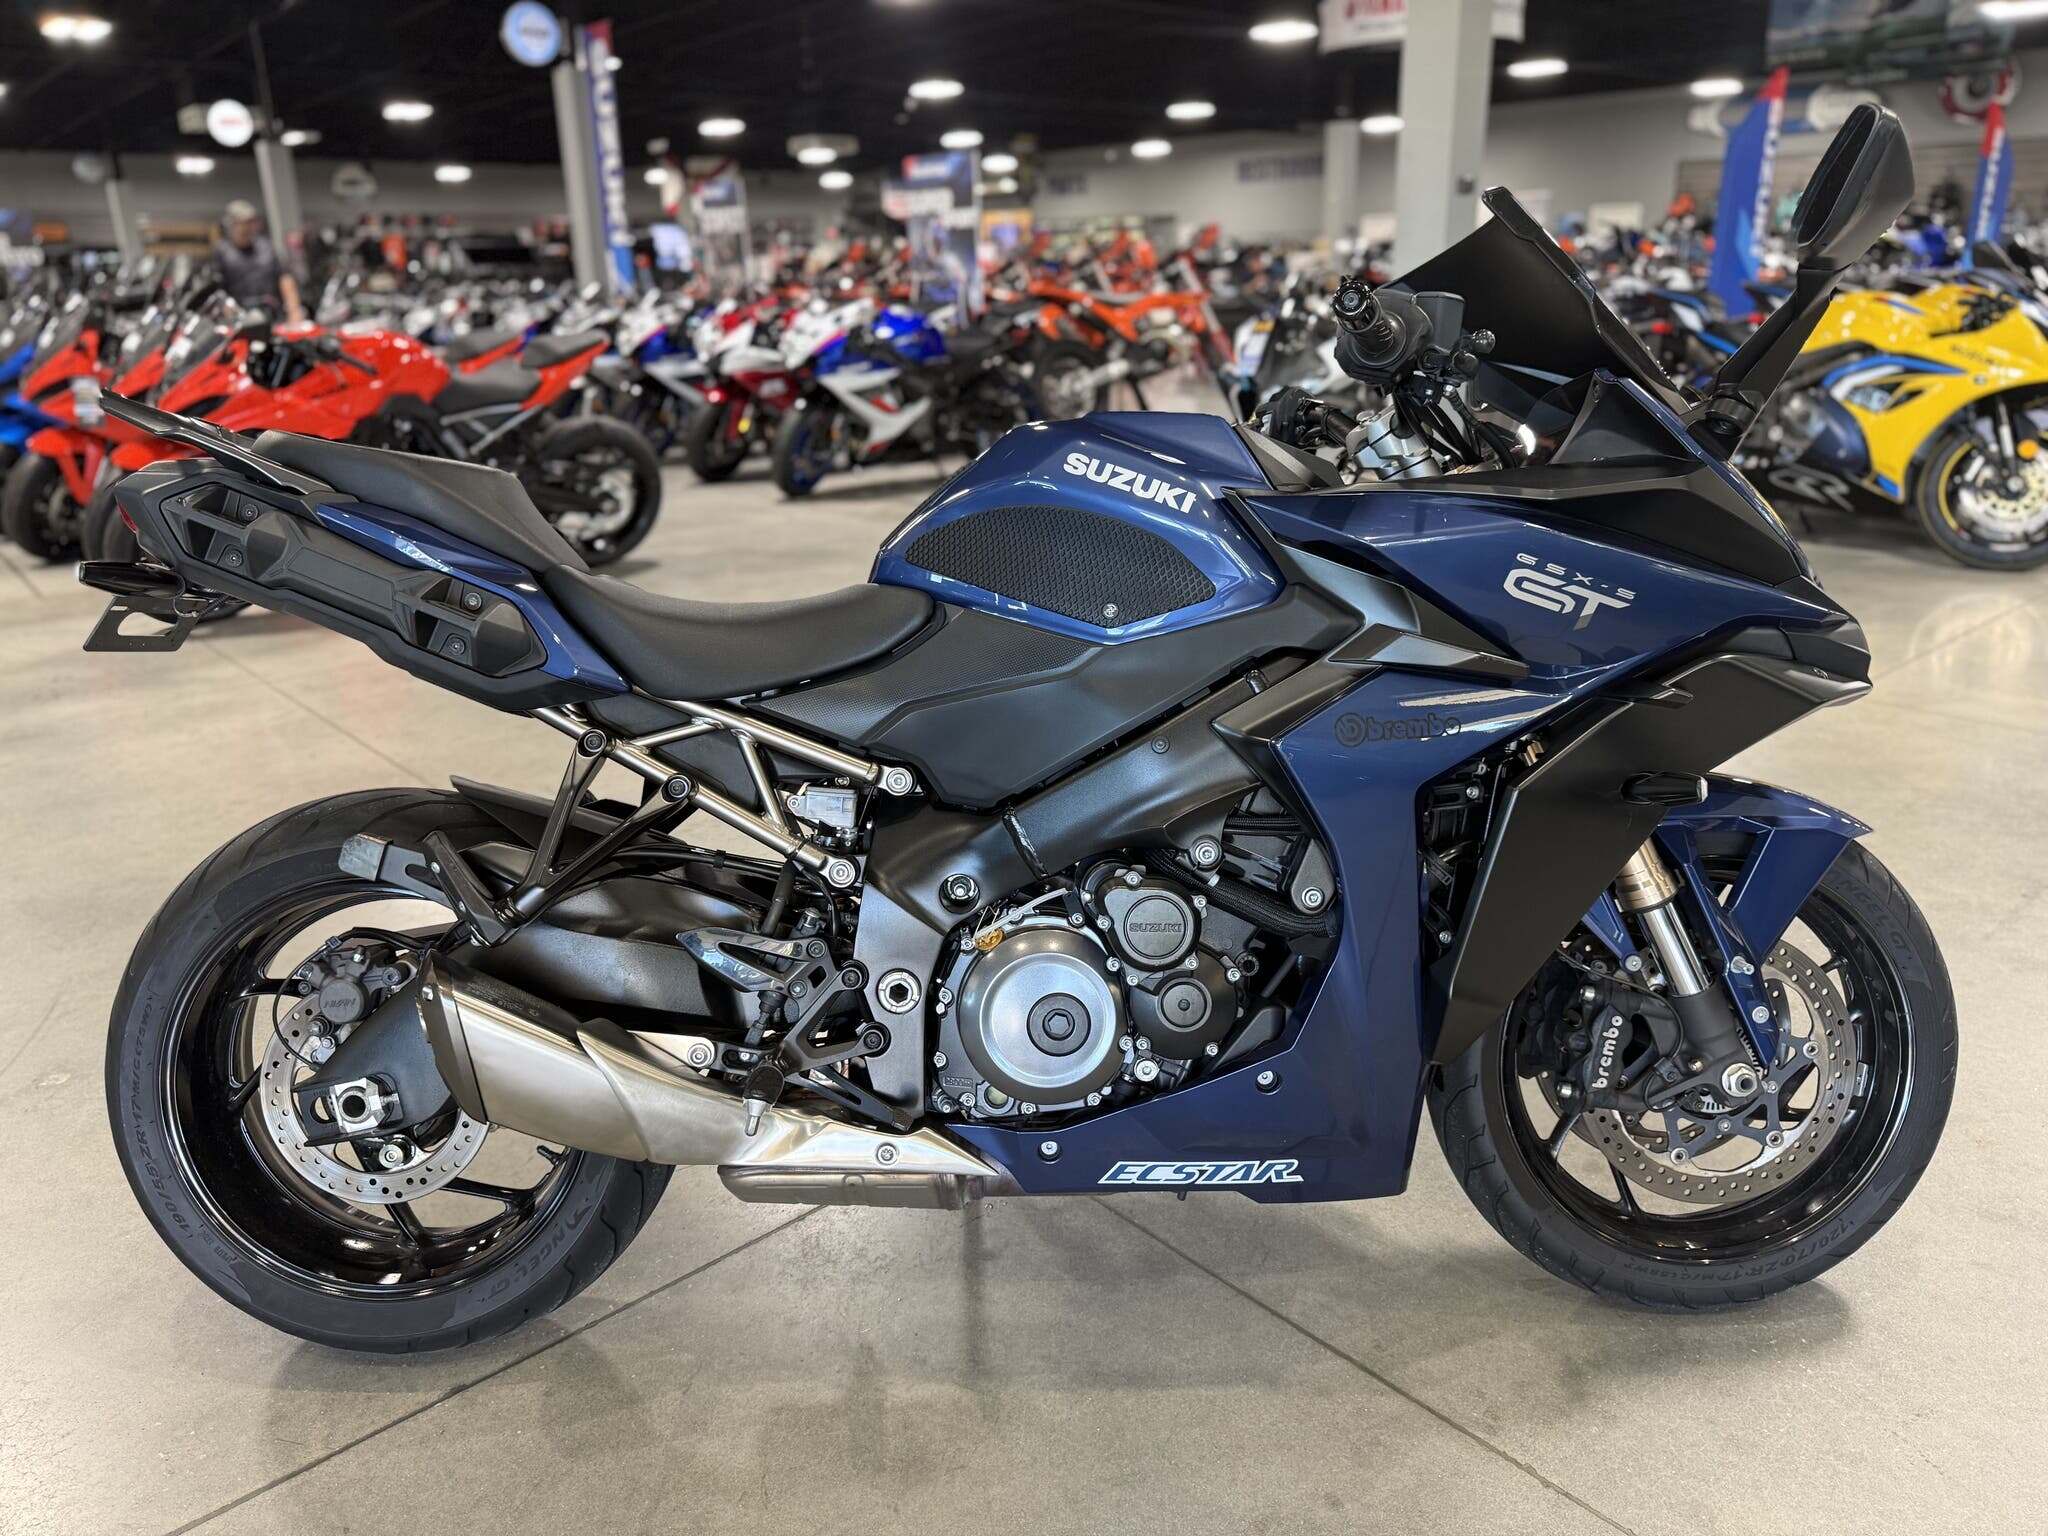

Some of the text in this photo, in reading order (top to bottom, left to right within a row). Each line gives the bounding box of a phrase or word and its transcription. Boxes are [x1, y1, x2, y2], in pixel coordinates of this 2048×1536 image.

[1063, 452, 1197, 514] SUZUKI
[1503, 568, 1631, 631] GT
[1516, 552, 1636, 600] GSX-S
[1365, 712, 1461, 742] brembo
[1129, 922, 1183, 933] SUZUKI
[1591, 1015, 1623, 1089] brembo
[1097, 1159, 1304, 1185] ECSTAR
[1784, 1221, 1850, 1268] 120/70
